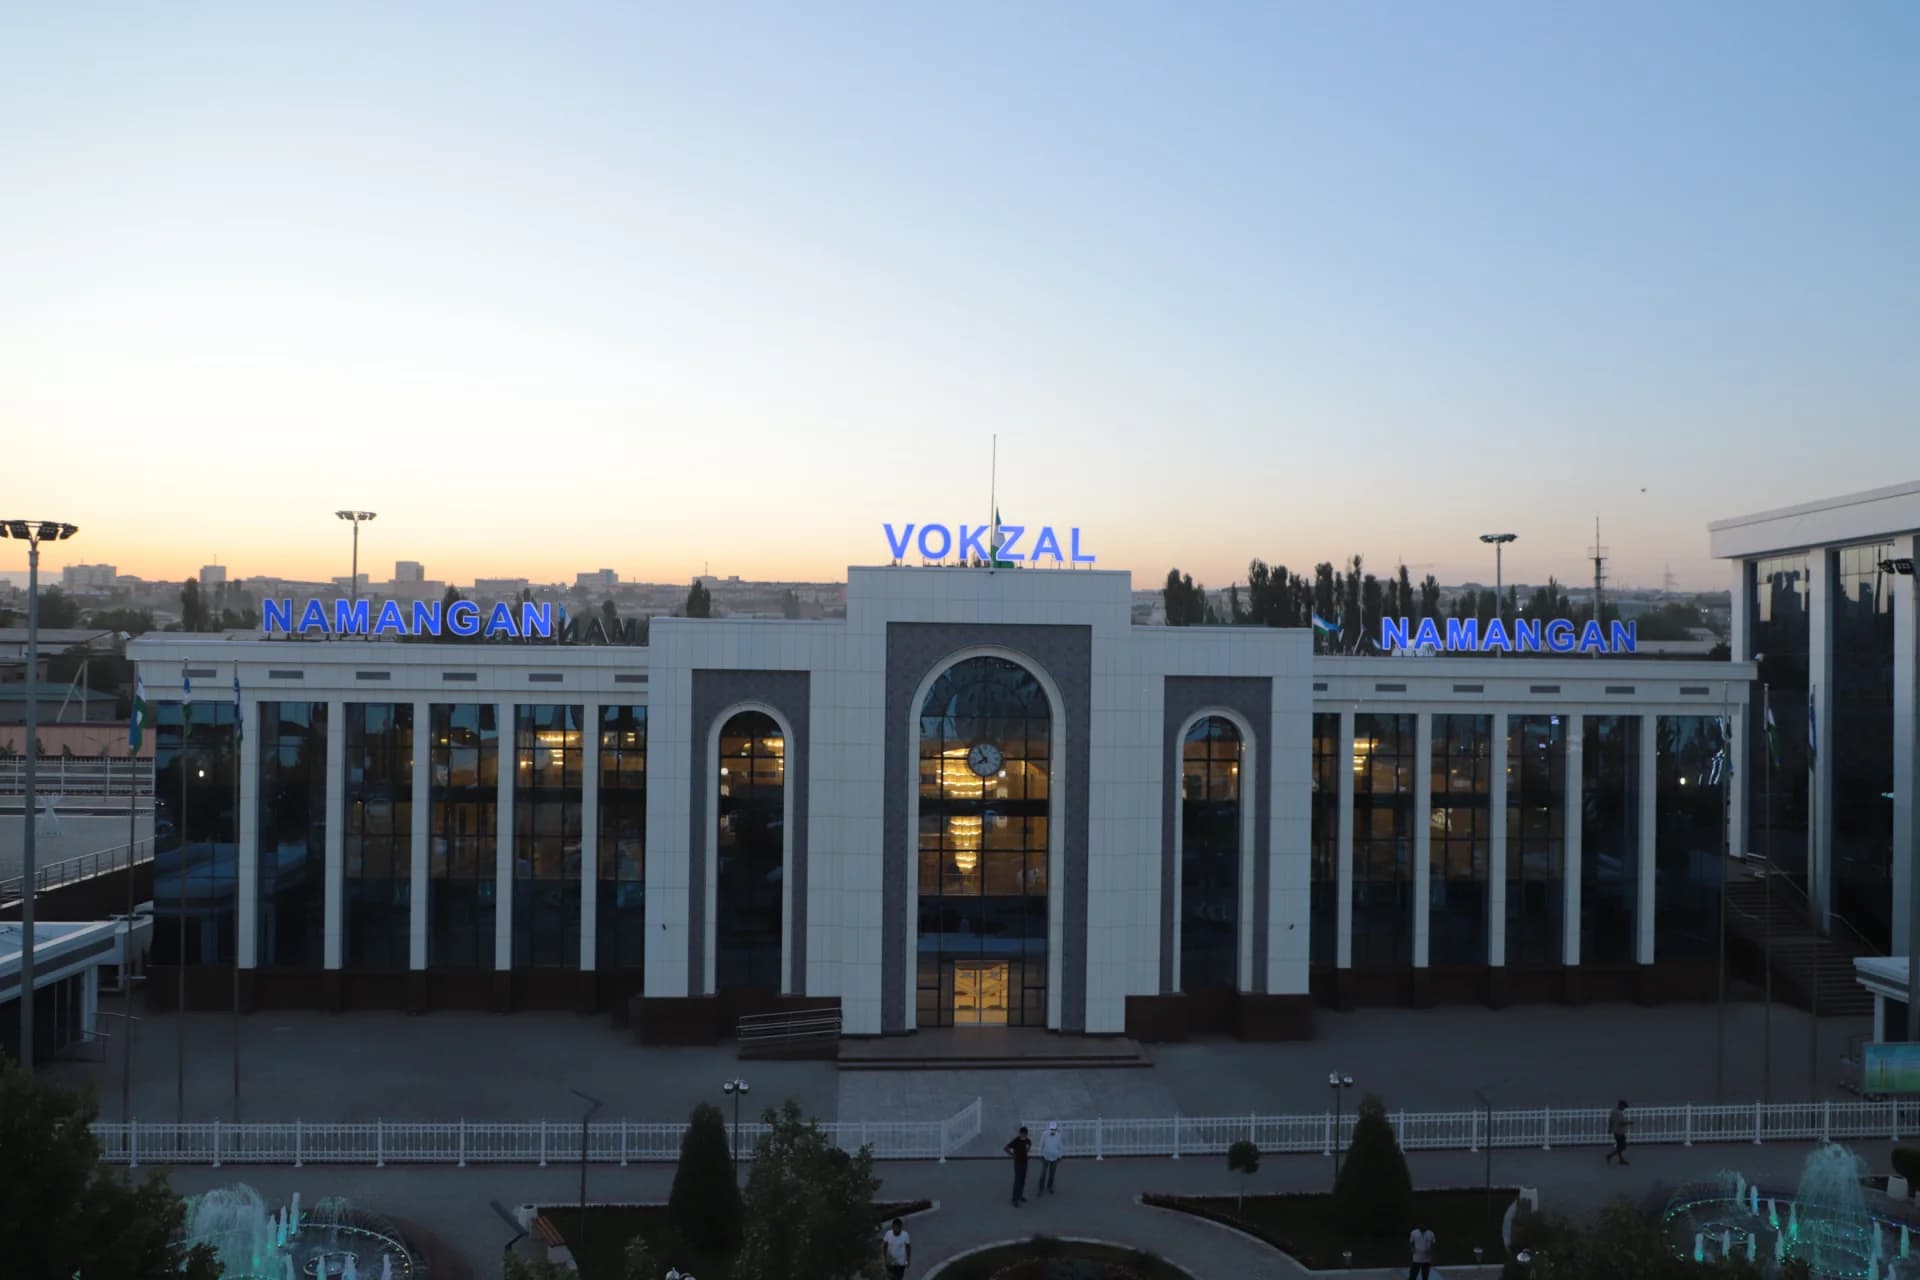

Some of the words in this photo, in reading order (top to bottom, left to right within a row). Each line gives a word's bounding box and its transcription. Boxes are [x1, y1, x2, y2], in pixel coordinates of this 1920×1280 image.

[883, 523, 1096, 562] VOKZAL
[263, 598, 552, 638] NAMANGAN
[1382, 616, 1637, 653] NAMANGAN
